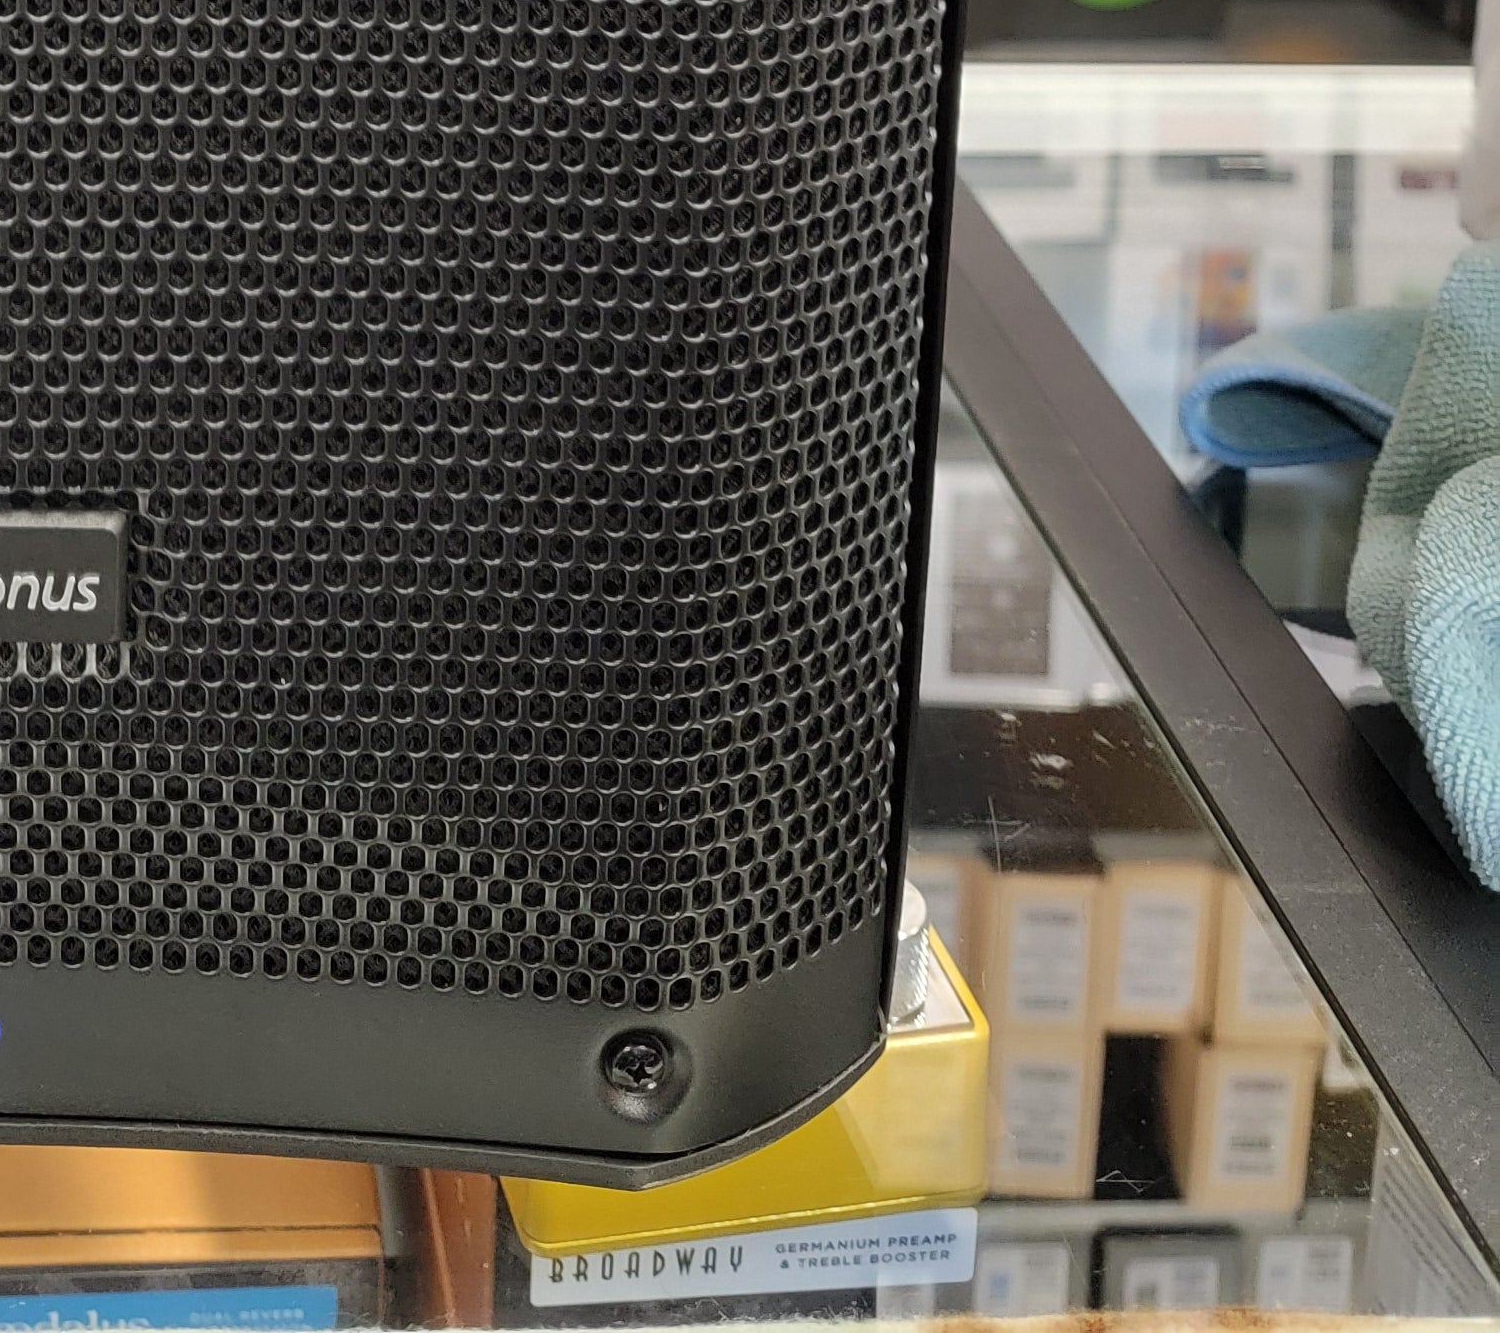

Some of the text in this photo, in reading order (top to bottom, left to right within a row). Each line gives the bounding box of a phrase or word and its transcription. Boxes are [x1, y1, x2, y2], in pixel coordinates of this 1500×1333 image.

[775, 1233, 958, 1254] GERMANIUM PREAMP
[549, 1245, 743, 1283] BROADWAY
[798, 1254, 862, 1269] TREBLE
[869, 1249, 950, 1265] BOOSTER
